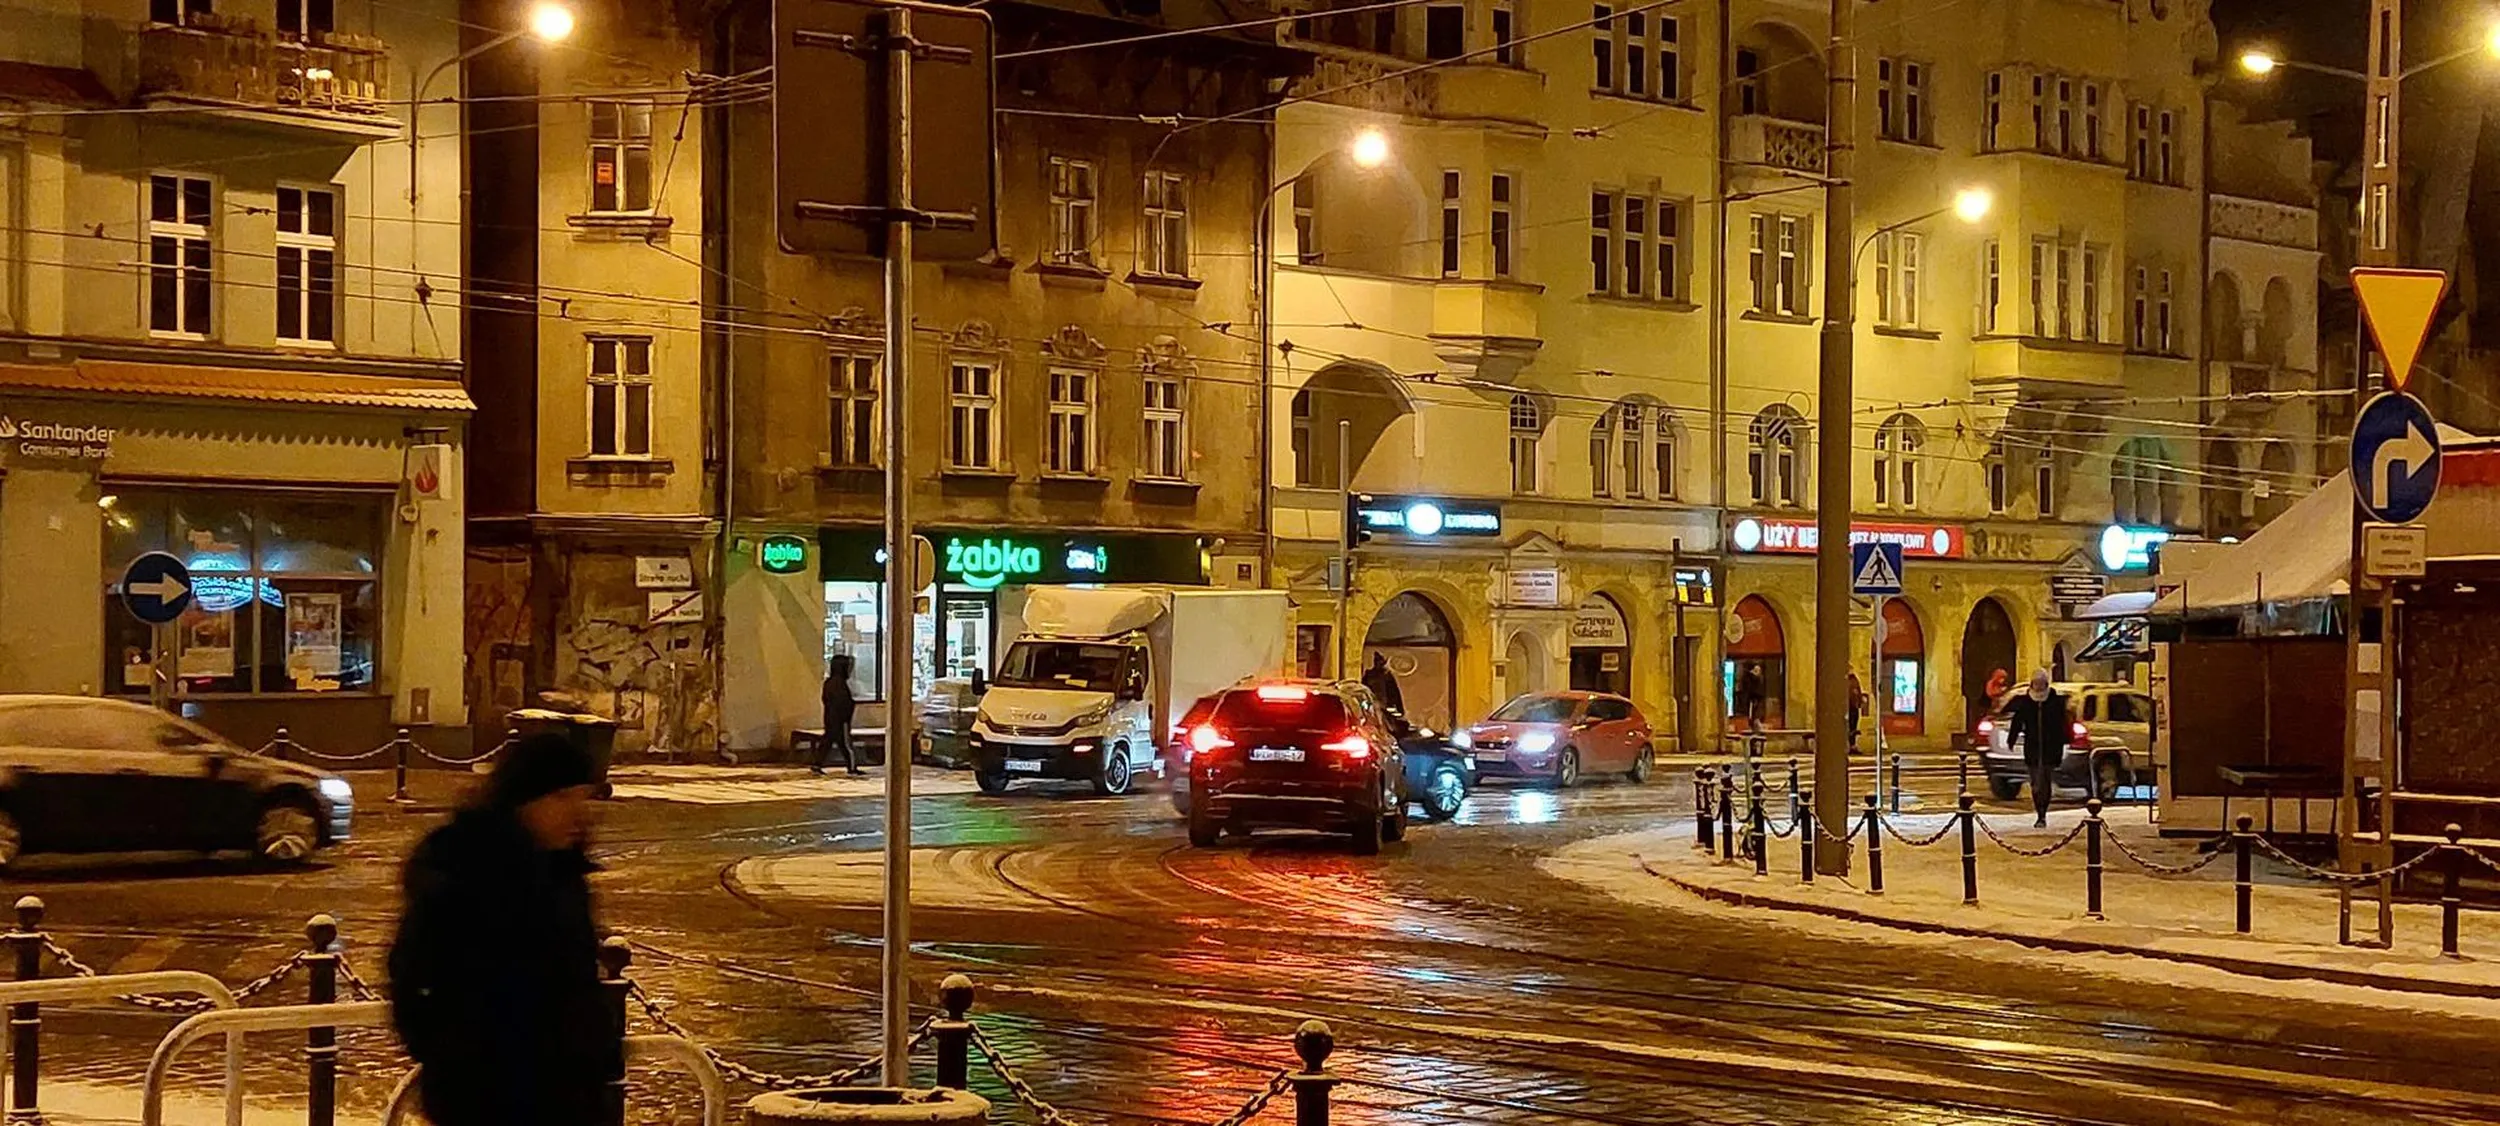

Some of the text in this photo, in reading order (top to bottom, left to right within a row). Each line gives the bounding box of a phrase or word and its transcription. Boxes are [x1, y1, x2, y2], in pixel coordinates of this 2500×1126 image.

[20, 421, 116, 442] Santander
[20, 442, 115, 458] Consumer Bank
[764, 543, 802, 562] żabka
[946, 538, 1041, 573] żabka
